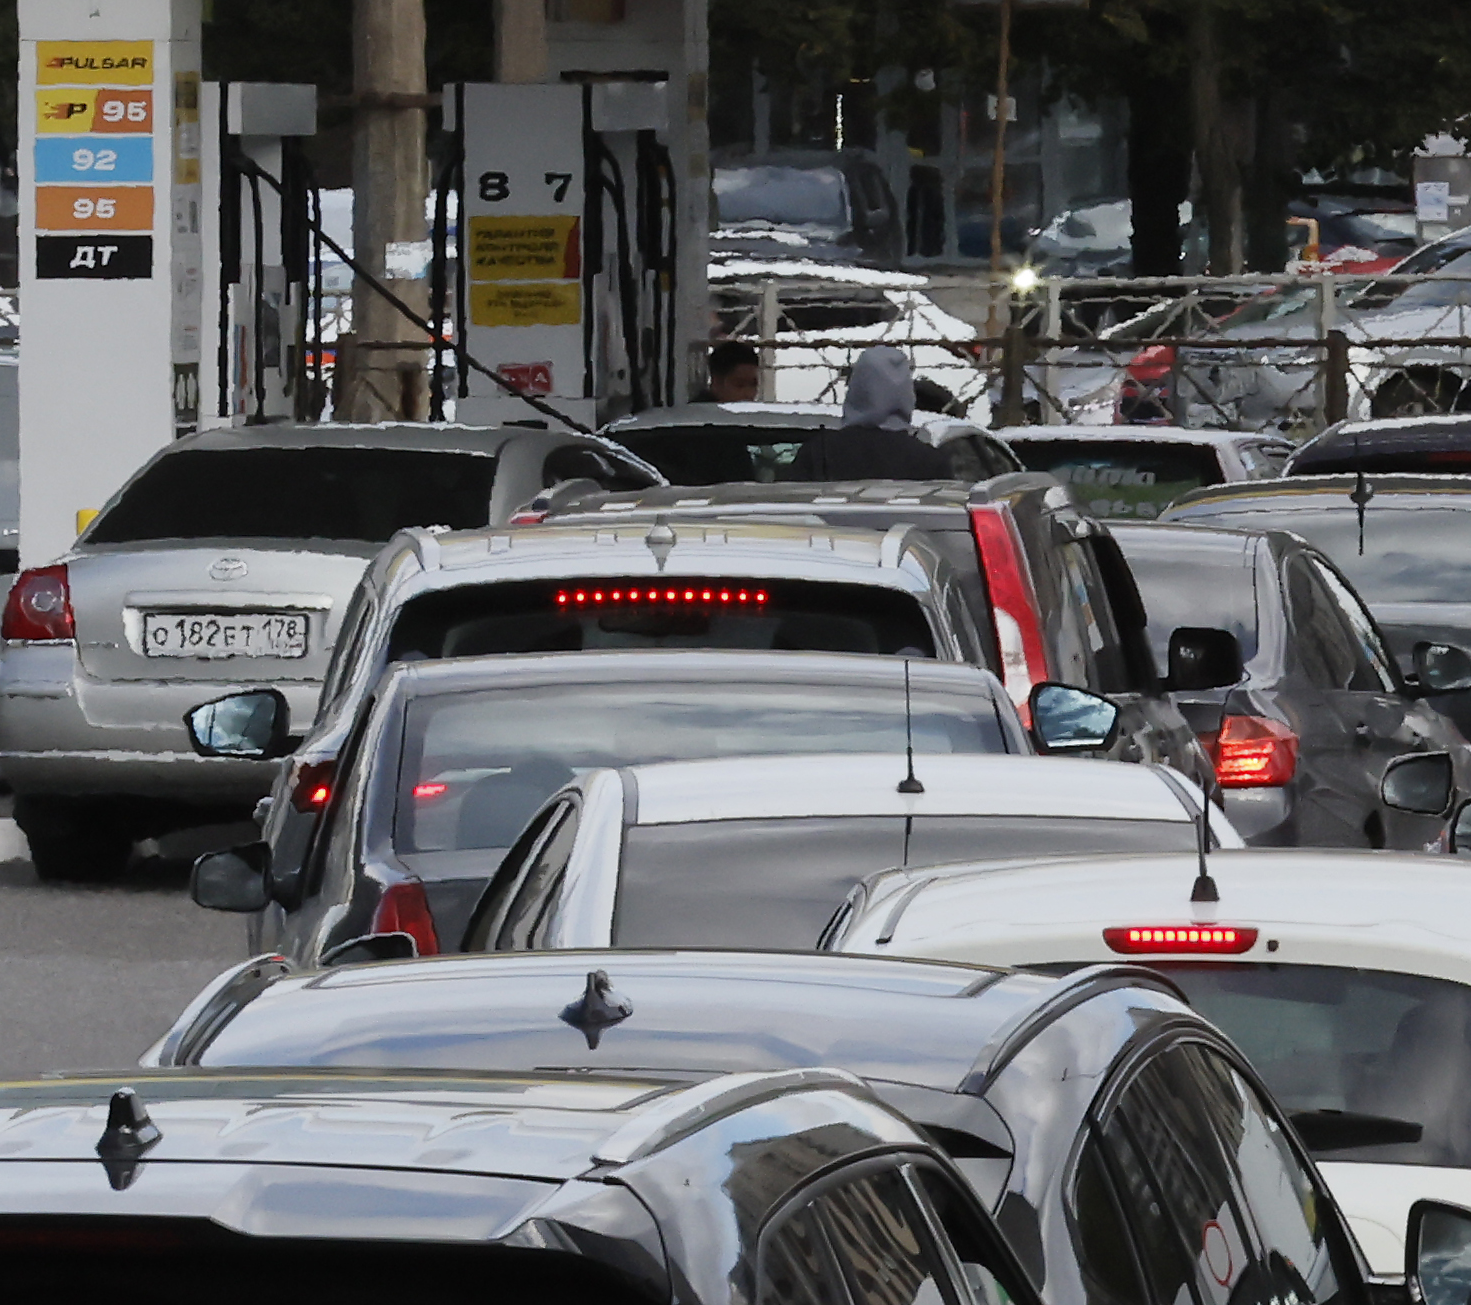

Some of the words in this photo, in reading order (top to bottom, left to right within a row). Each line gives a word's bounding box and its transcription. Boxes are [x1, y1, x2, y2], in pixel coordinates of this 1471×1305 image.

[61, 57, 148, 70] PULSAR
[102, 100, 147, 122] 95
[71, 149, 118, 171] 92
[479, 171, 510, 202] 8
[544, 172, 573, 203] 7
[73, 198, 117, 219] 95
[69, 245, 118, 268] ДТ
